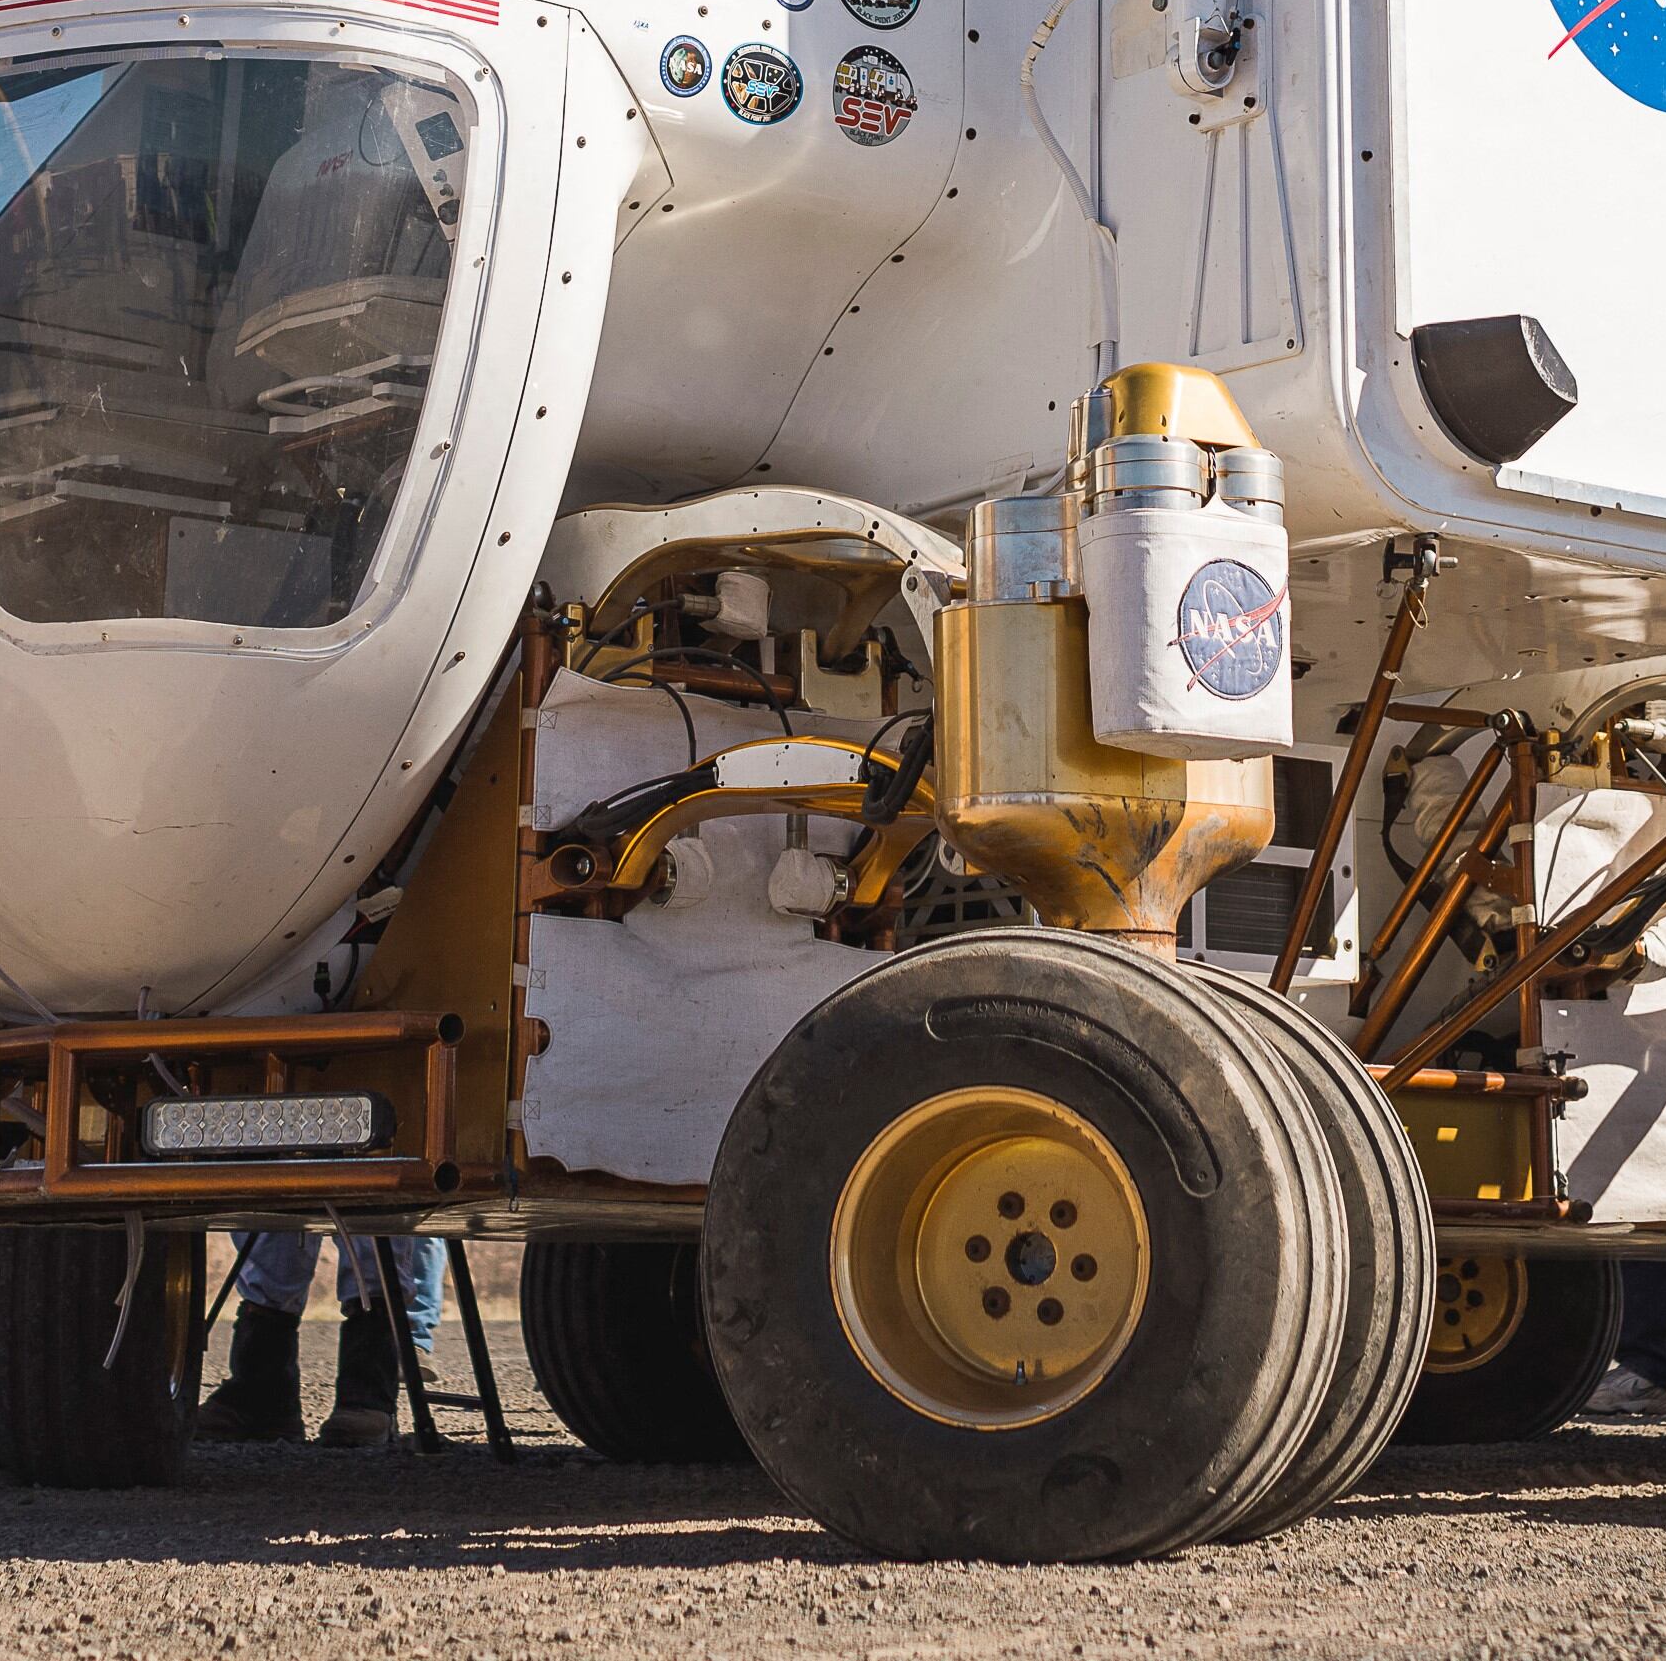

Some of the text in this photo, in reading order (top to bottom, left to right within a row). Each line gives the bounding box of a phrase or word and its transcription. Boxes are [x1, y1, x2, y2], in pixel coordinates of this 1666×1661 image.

[856, 6, 873, 21] BLACK
[874, 15, 891, 24] POINT
[668, 57, 703, 76] NASA
[746, 79, 780, 98] SEV
[834, 96, 912, 136] SEV
[1189, 608, 1279, 648] NASA
